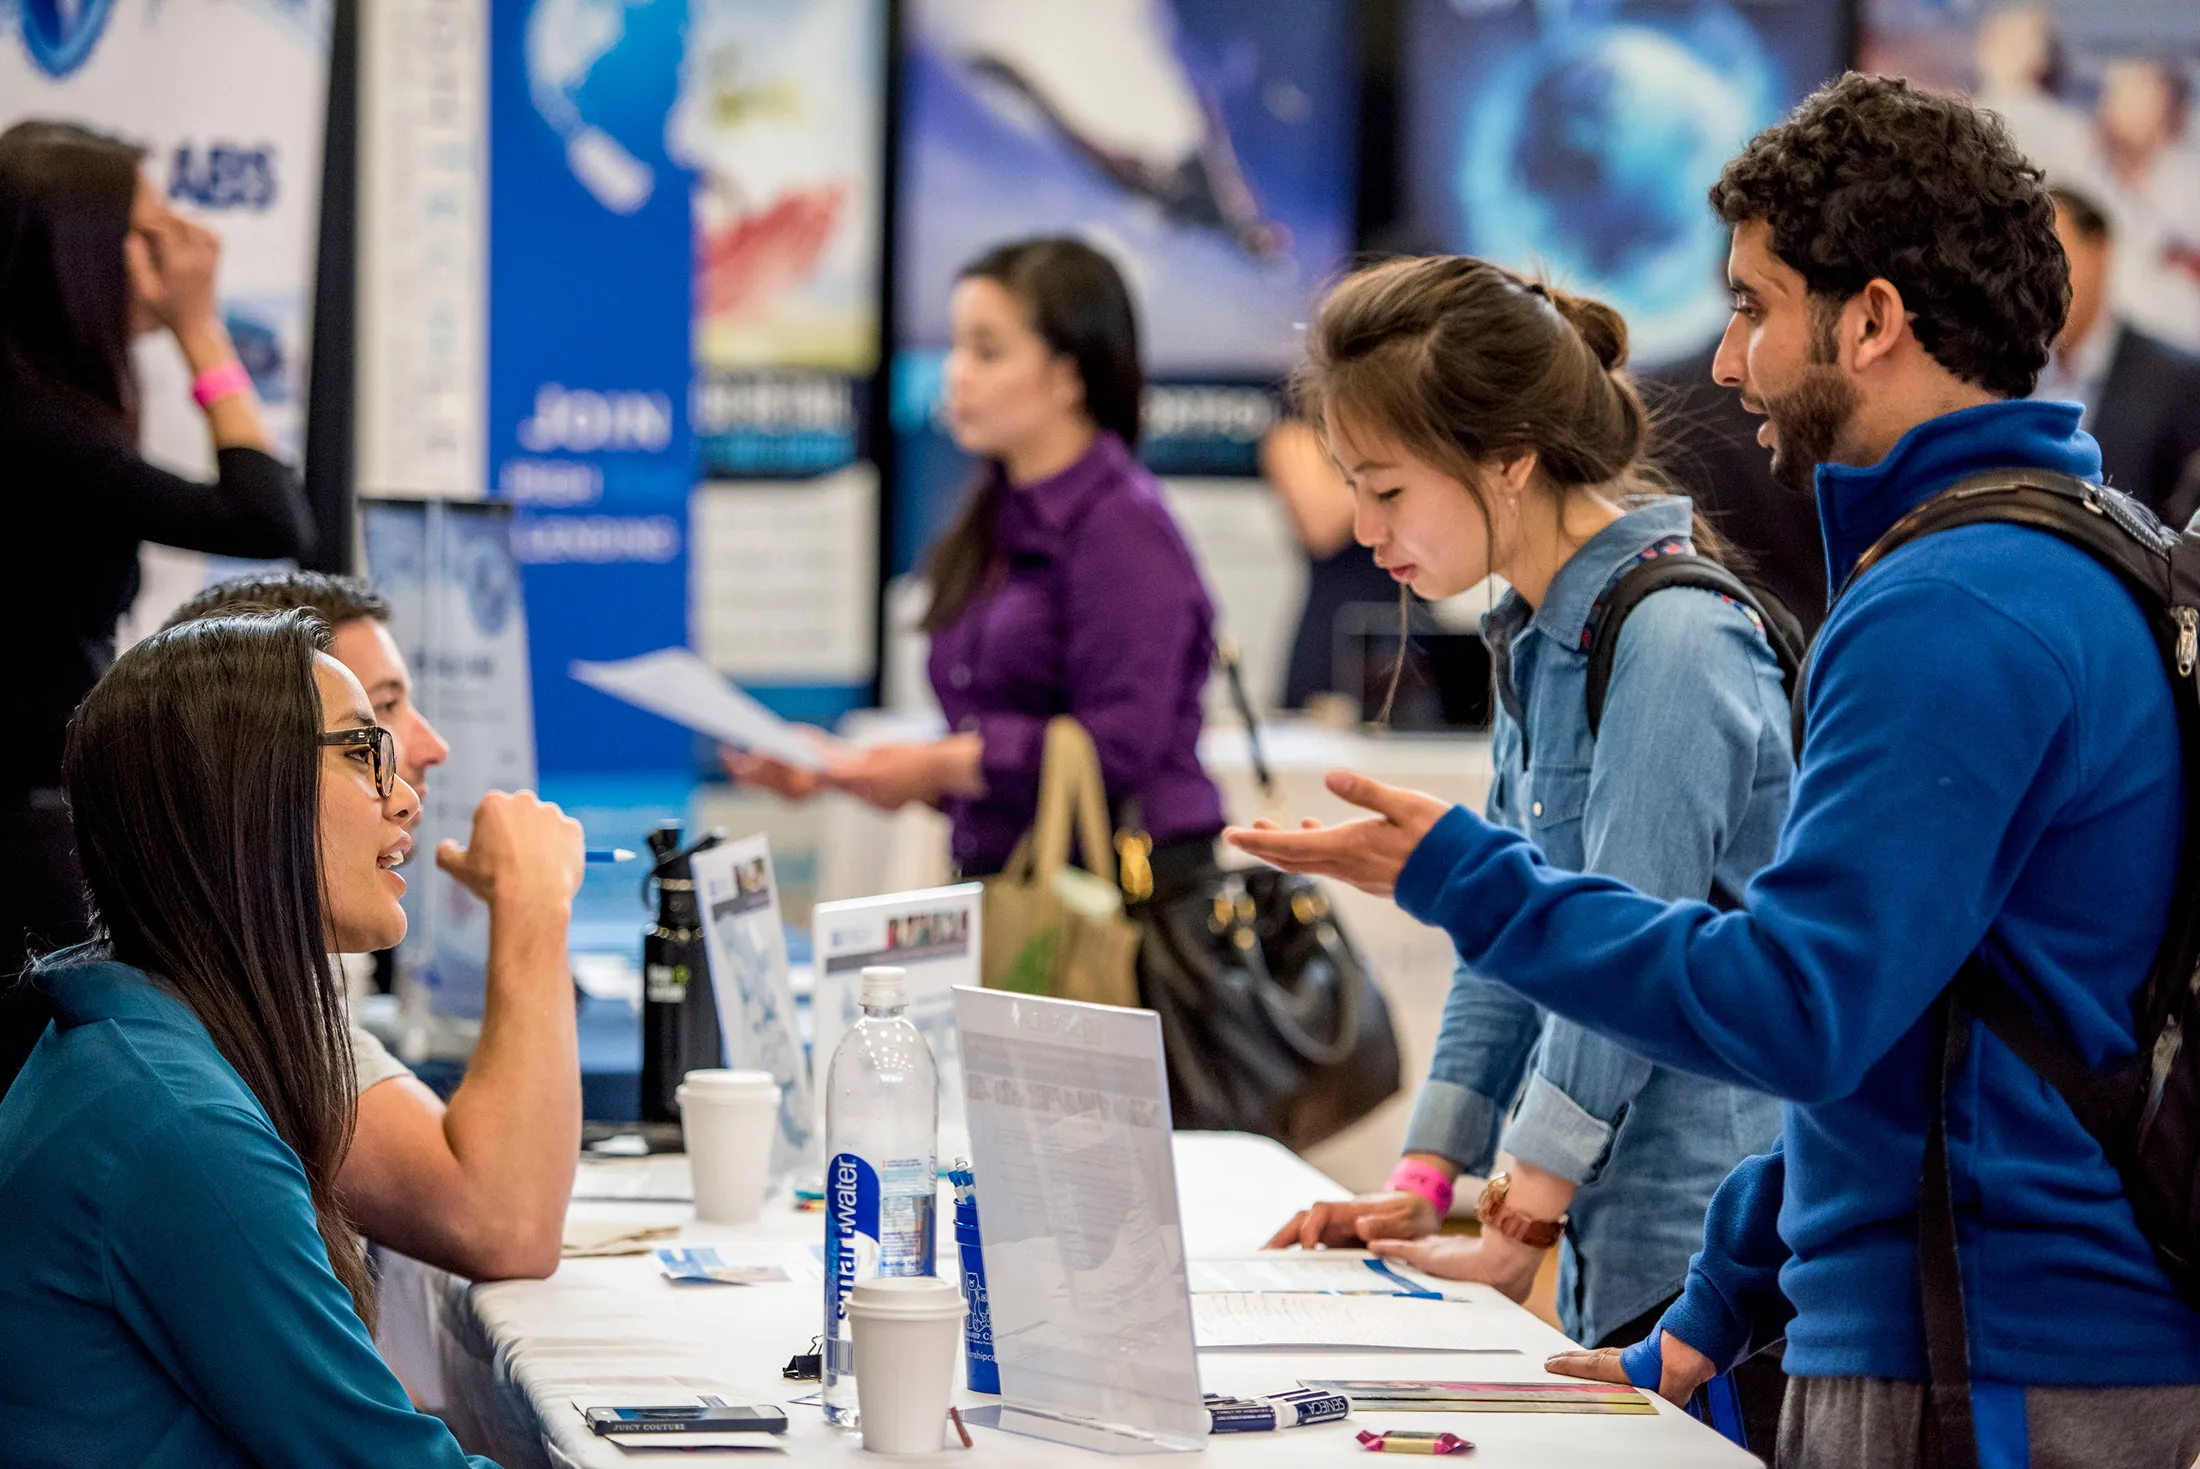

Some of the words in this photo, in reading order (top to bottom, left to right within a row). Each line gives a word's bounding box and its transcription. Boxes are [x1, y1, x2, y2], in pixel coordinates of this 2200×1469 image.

[519, 384, 671, 452] JOIN
[835, 1155, 857, 1320] smartwater
[613, 1423, 640, 1431] JUICY
[643, 1423, 686, 1431] COUTURE
[1308, 1398, 1346, 1415] SENECA
